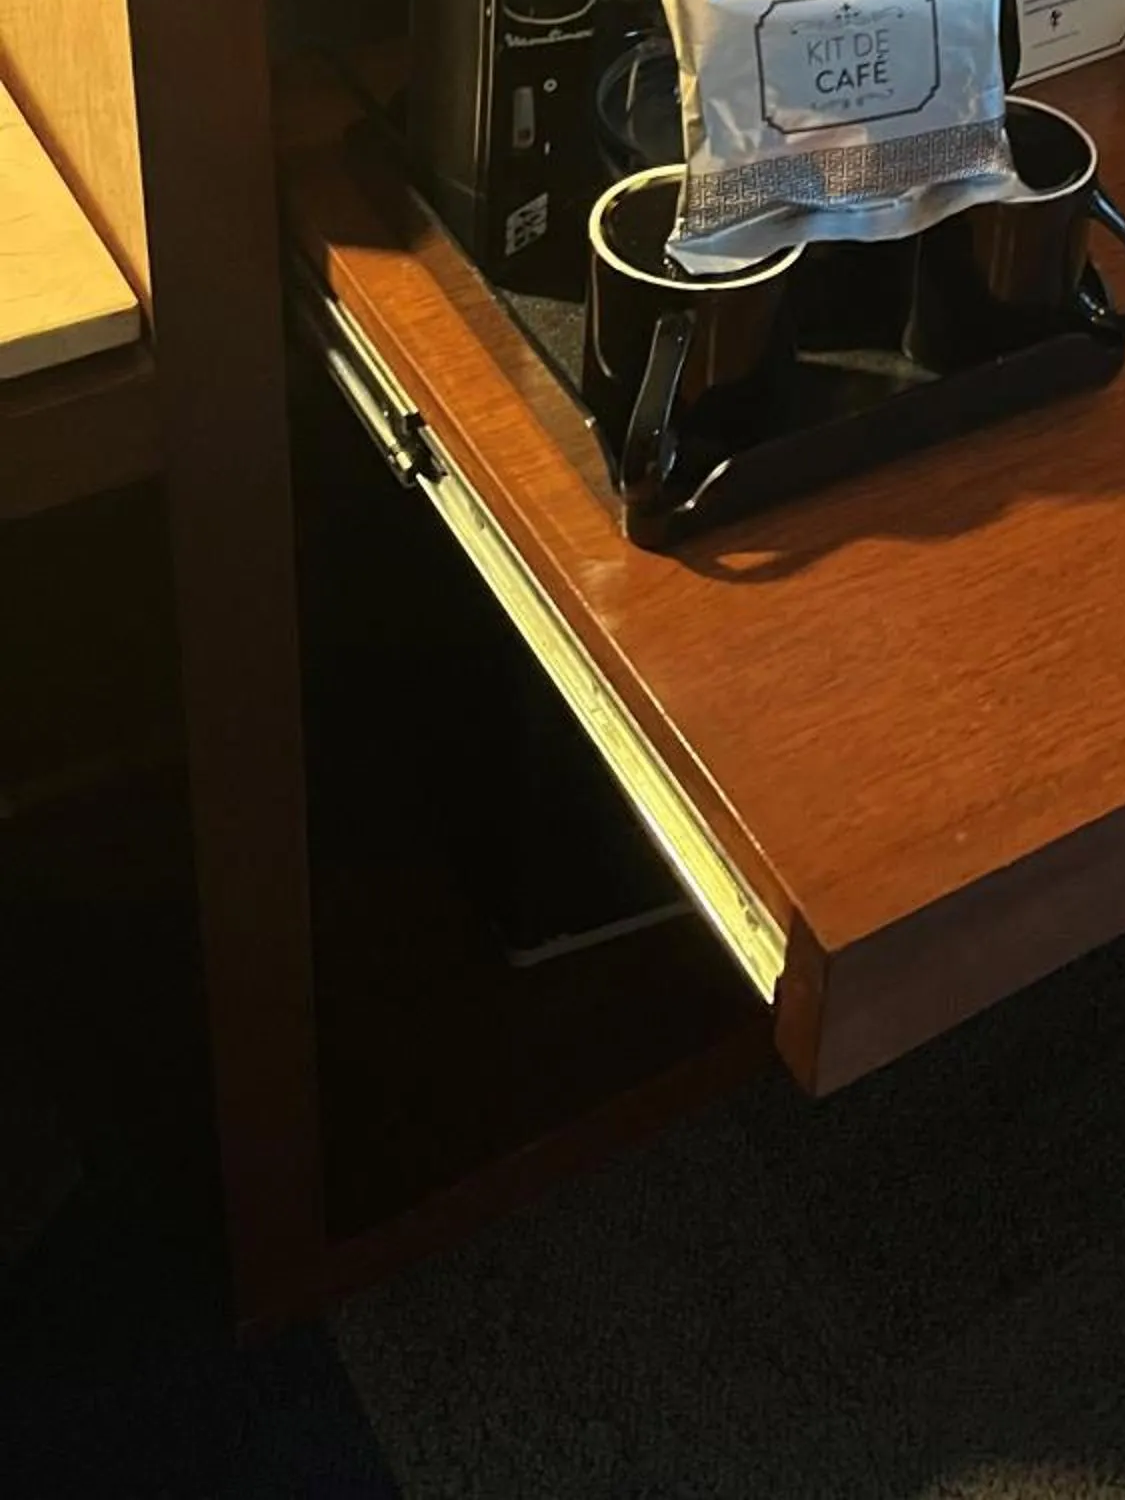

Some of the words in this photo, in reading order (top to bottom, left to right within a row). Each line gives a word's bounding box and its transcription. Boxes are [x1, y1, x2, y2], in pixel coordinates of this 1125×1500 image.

[807, 35, 844, 66] KIT
[853, 28, 889, 58] DE
[815, 54, 889, 94] CAFÉ
